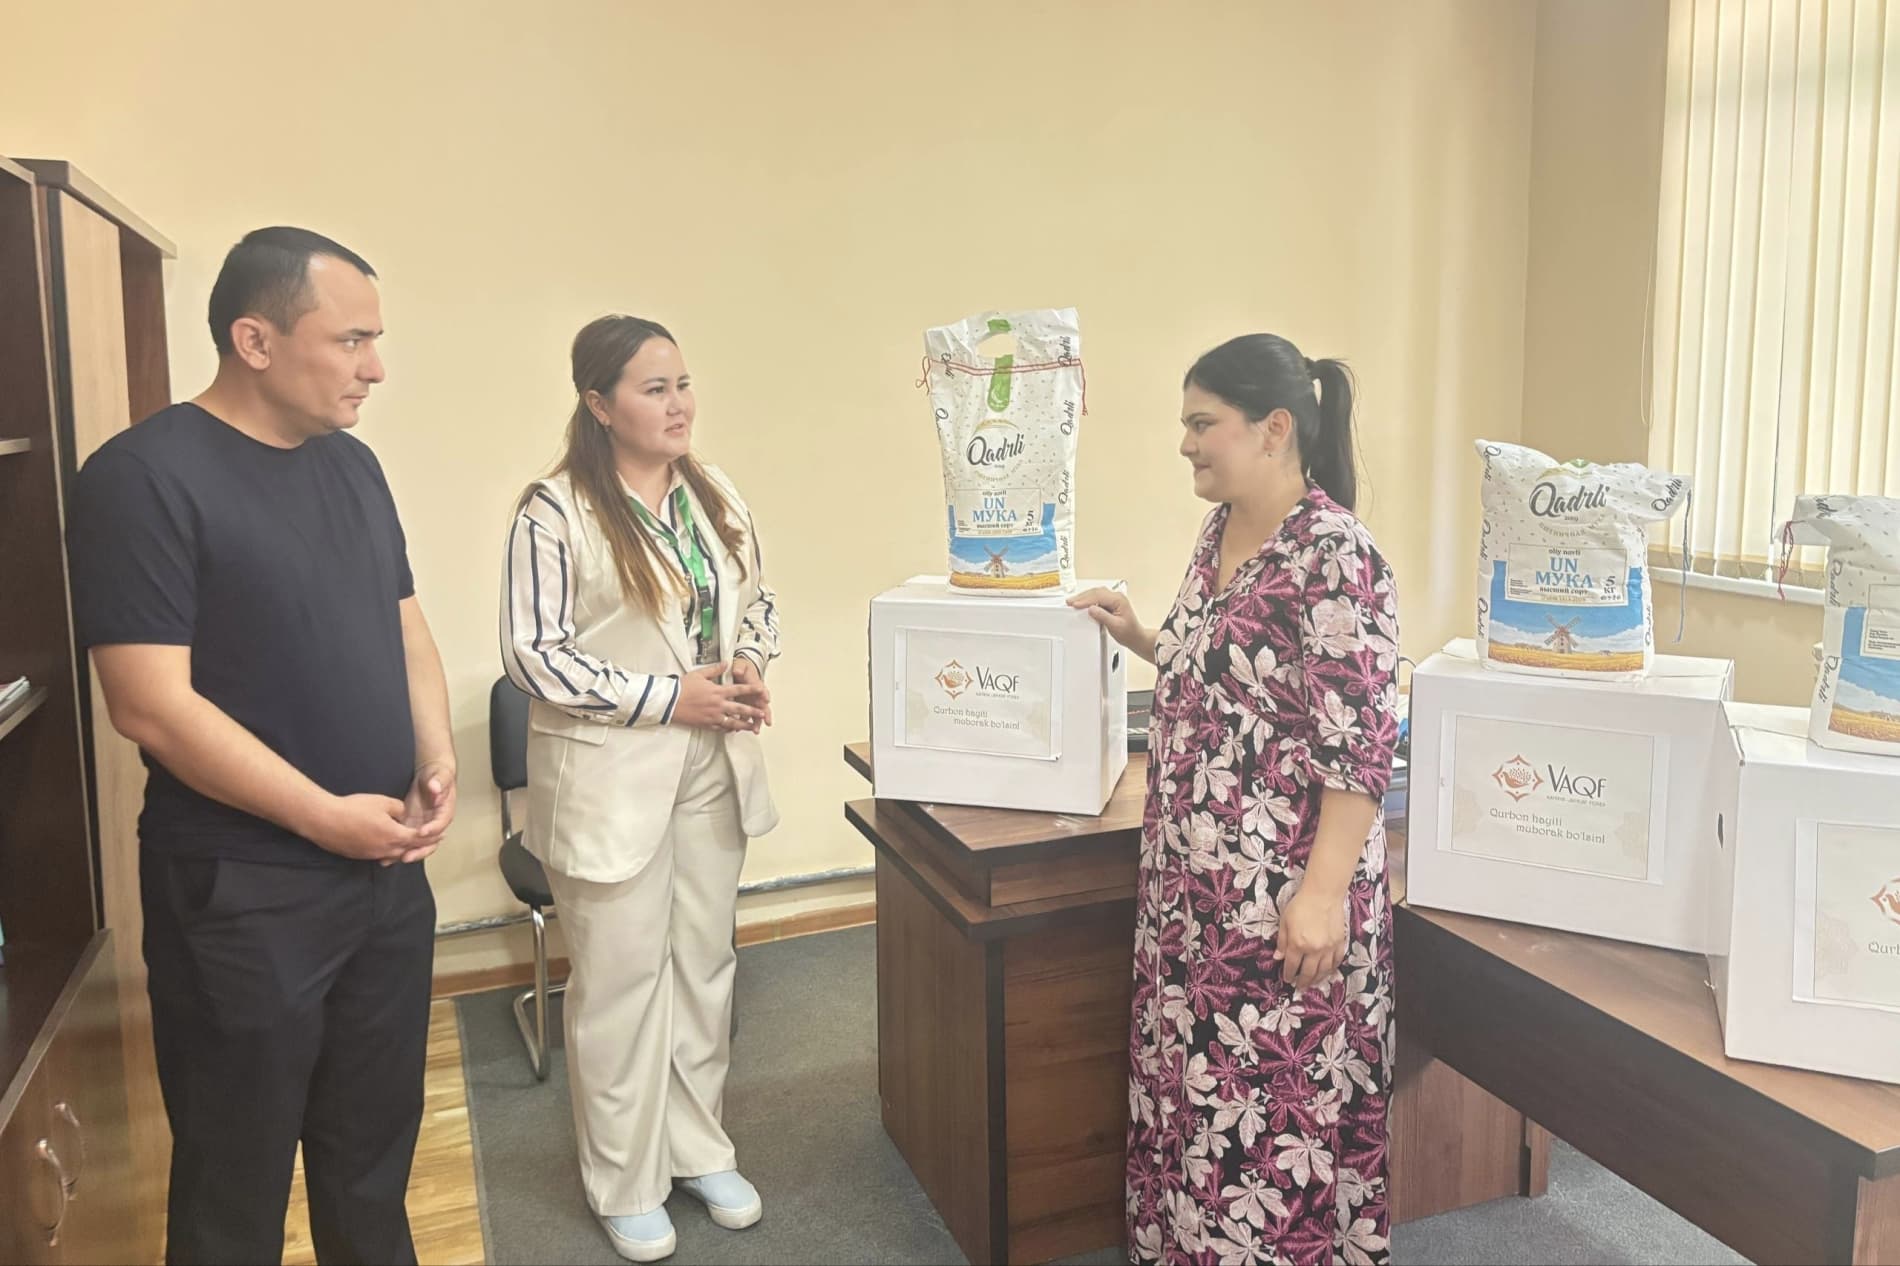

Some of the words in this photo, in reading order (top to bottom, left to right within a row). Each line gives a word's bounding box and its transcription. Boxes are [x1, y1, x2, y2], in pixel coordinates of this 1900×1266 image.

[967, 433, 1025, 466] Qadrli
[984, 497, 1005, 509] UN
[1529, 482, 1610, 517] Qadrli
[973, 510, 1017, 522] МУКА
[1027, 510, 1034, 521] 5
[1550, 556, 1578, 573] UN
[1536, 571, 1593, 588] МУКА
[1605, 576, 1616, 587] 5
[976, 666, 1020, 693] VAQF
[1548, 764, 1606, 799] VAQF
[1489, 808, 1529, 822] Qurbon
[1516, 824, 1563, 839] muborak
